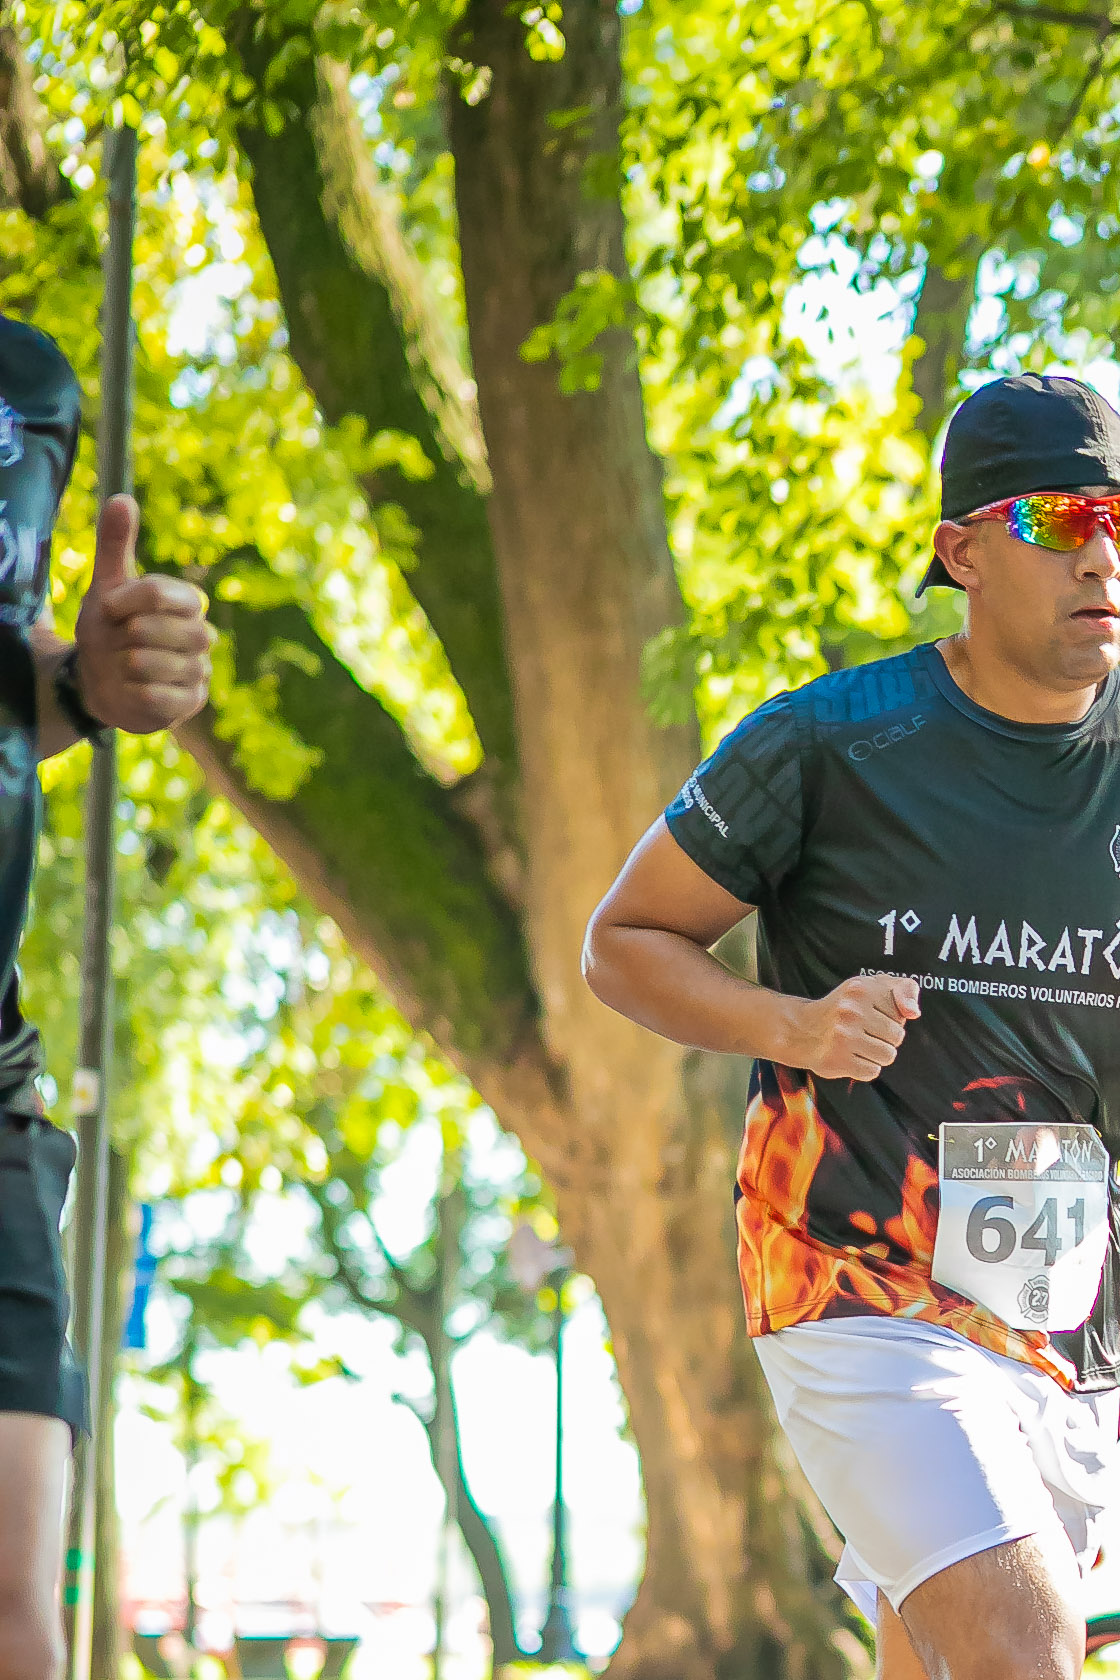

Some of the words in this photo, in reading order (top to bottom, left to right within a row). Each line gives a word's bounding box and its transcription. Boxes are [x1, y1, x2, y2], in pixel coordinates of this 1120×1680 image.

[947, 977, 1027, 1000] BOMBEROS
[1030, 986, 1115, 1008] VOLUNTARIOS
[1004, 1131, 1094, 1164] MATÓN
[951, 1166, 1007, 1180] ASOCIACIÓN
[966, 1195, 1085, 1267] 641
